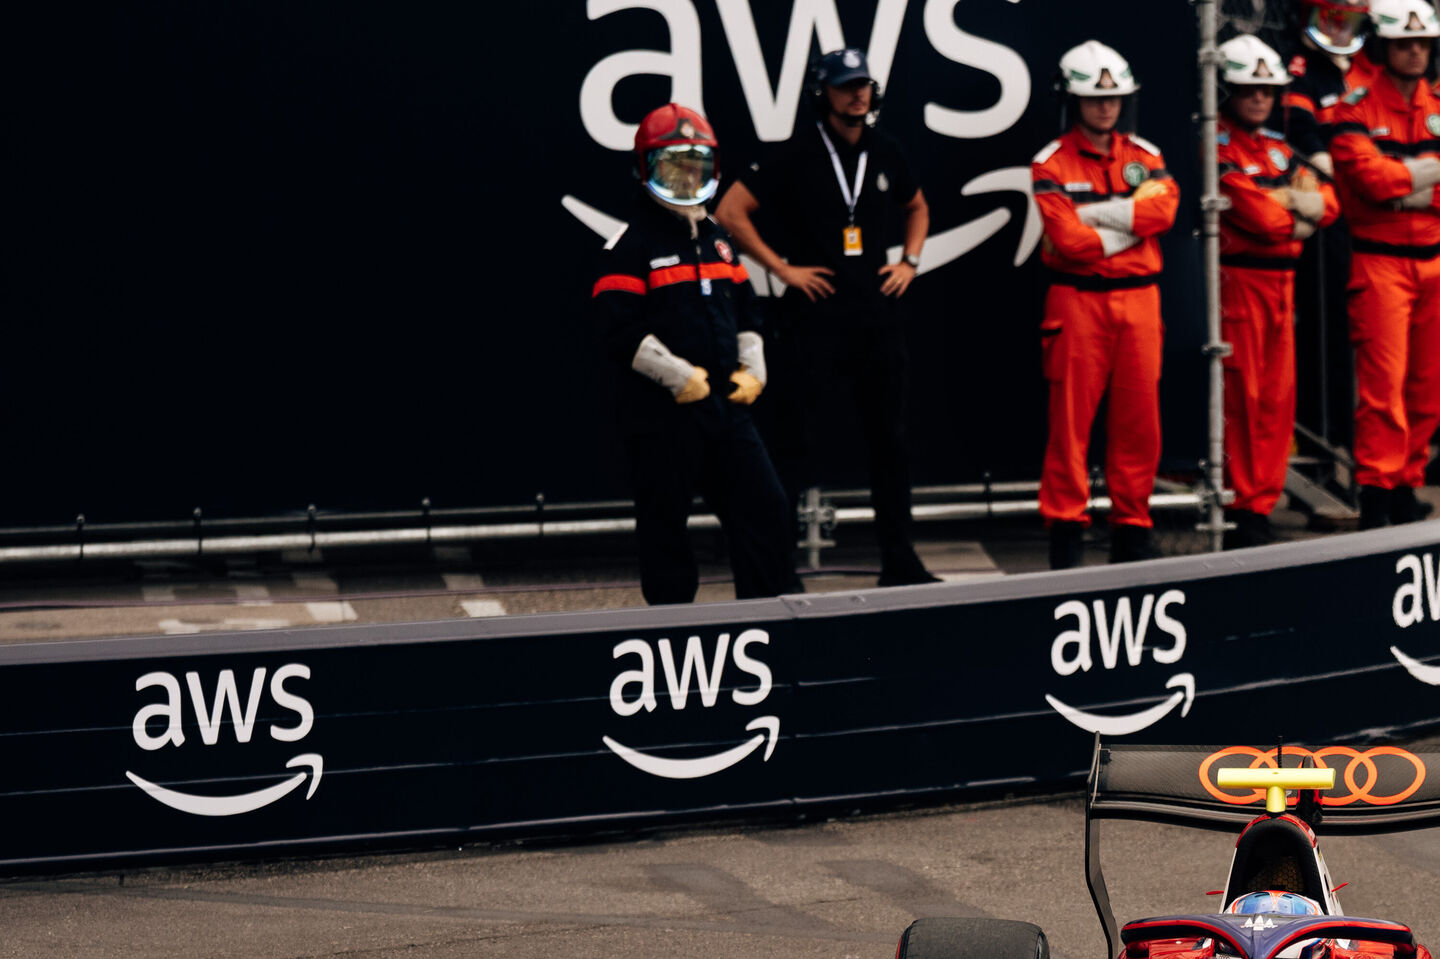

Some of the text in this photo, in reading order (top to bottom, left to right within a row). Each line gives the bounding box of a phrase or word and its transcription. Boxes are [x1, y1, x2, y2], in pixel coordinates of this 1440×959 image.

[581, 0, 1030, 150] aws
[609, 628, 773, 717] aws
[1050, 589, 1187, 676] aws
[132, 663, 314, 751] aws
